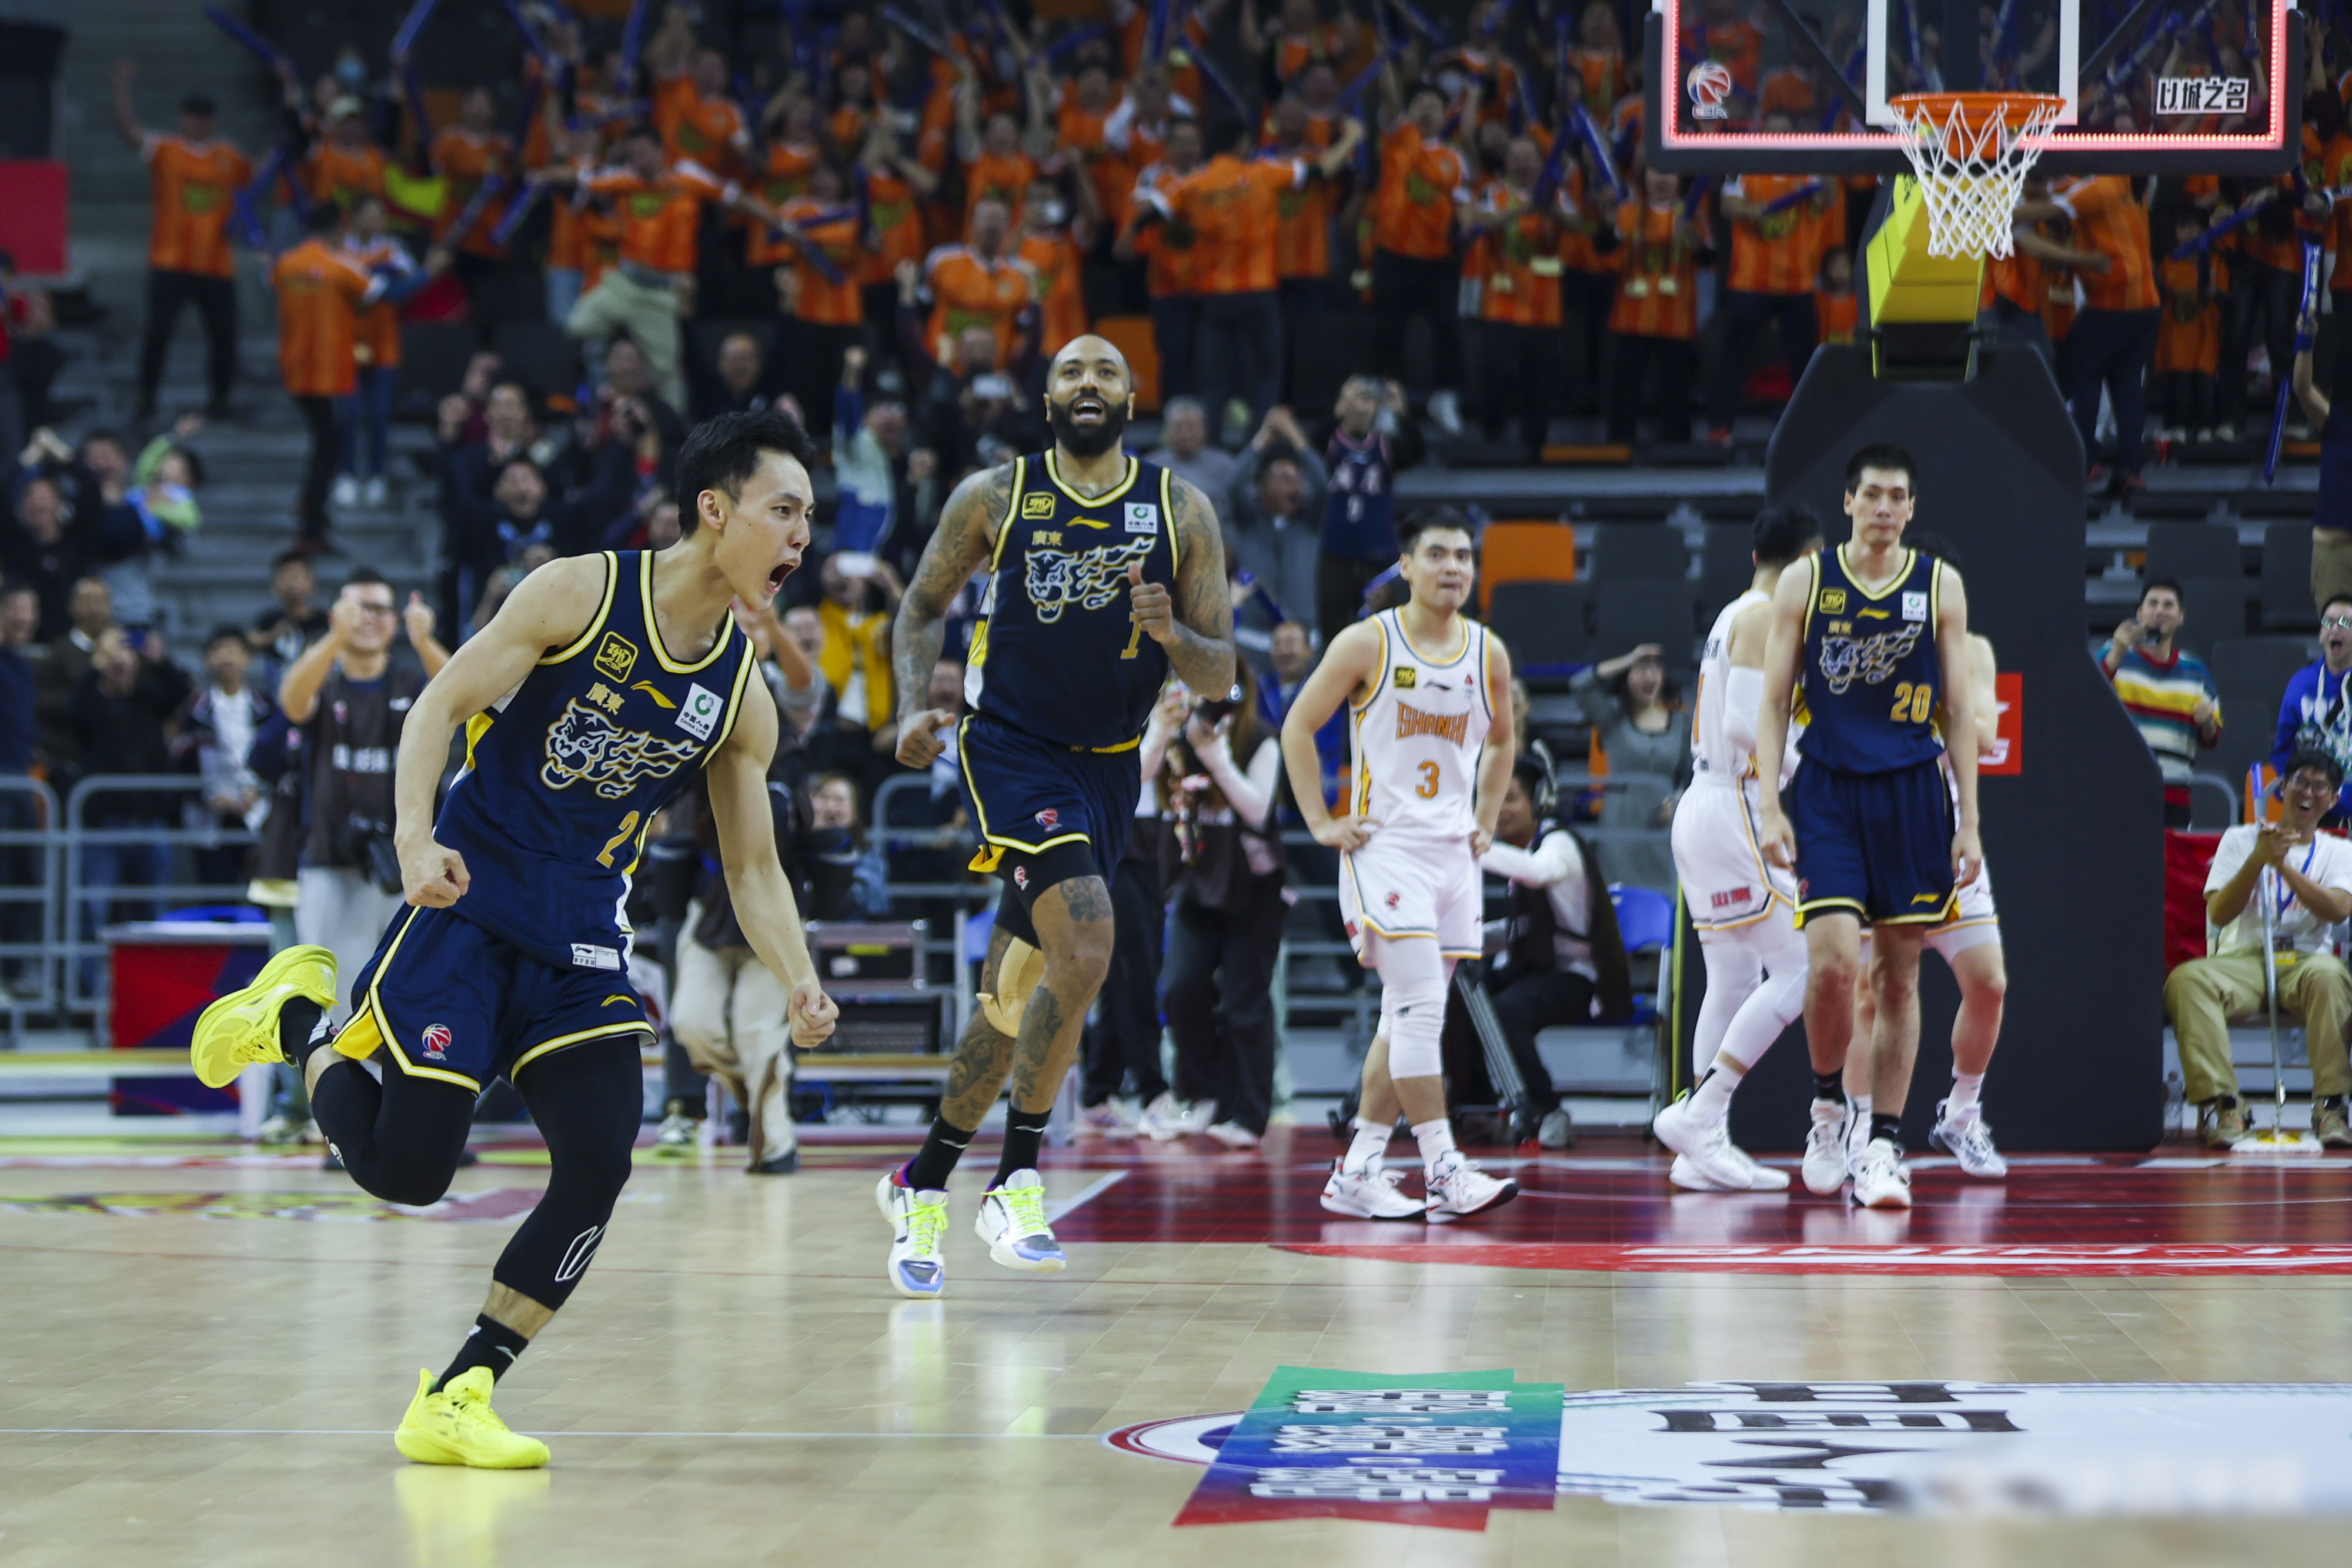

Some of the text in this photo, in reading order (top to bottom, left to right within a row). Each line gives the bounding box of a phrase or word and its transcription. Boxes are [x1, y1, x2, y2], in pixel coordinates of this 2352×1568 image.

[2157, 78, 2247, 112] 以城之名
[1890, 683, 1932, 724] 20
[1395, 700, 1470, 750] SHANXI
[1415, 760, 1439, 800] 3
[595, 811, 639, 868] 2
